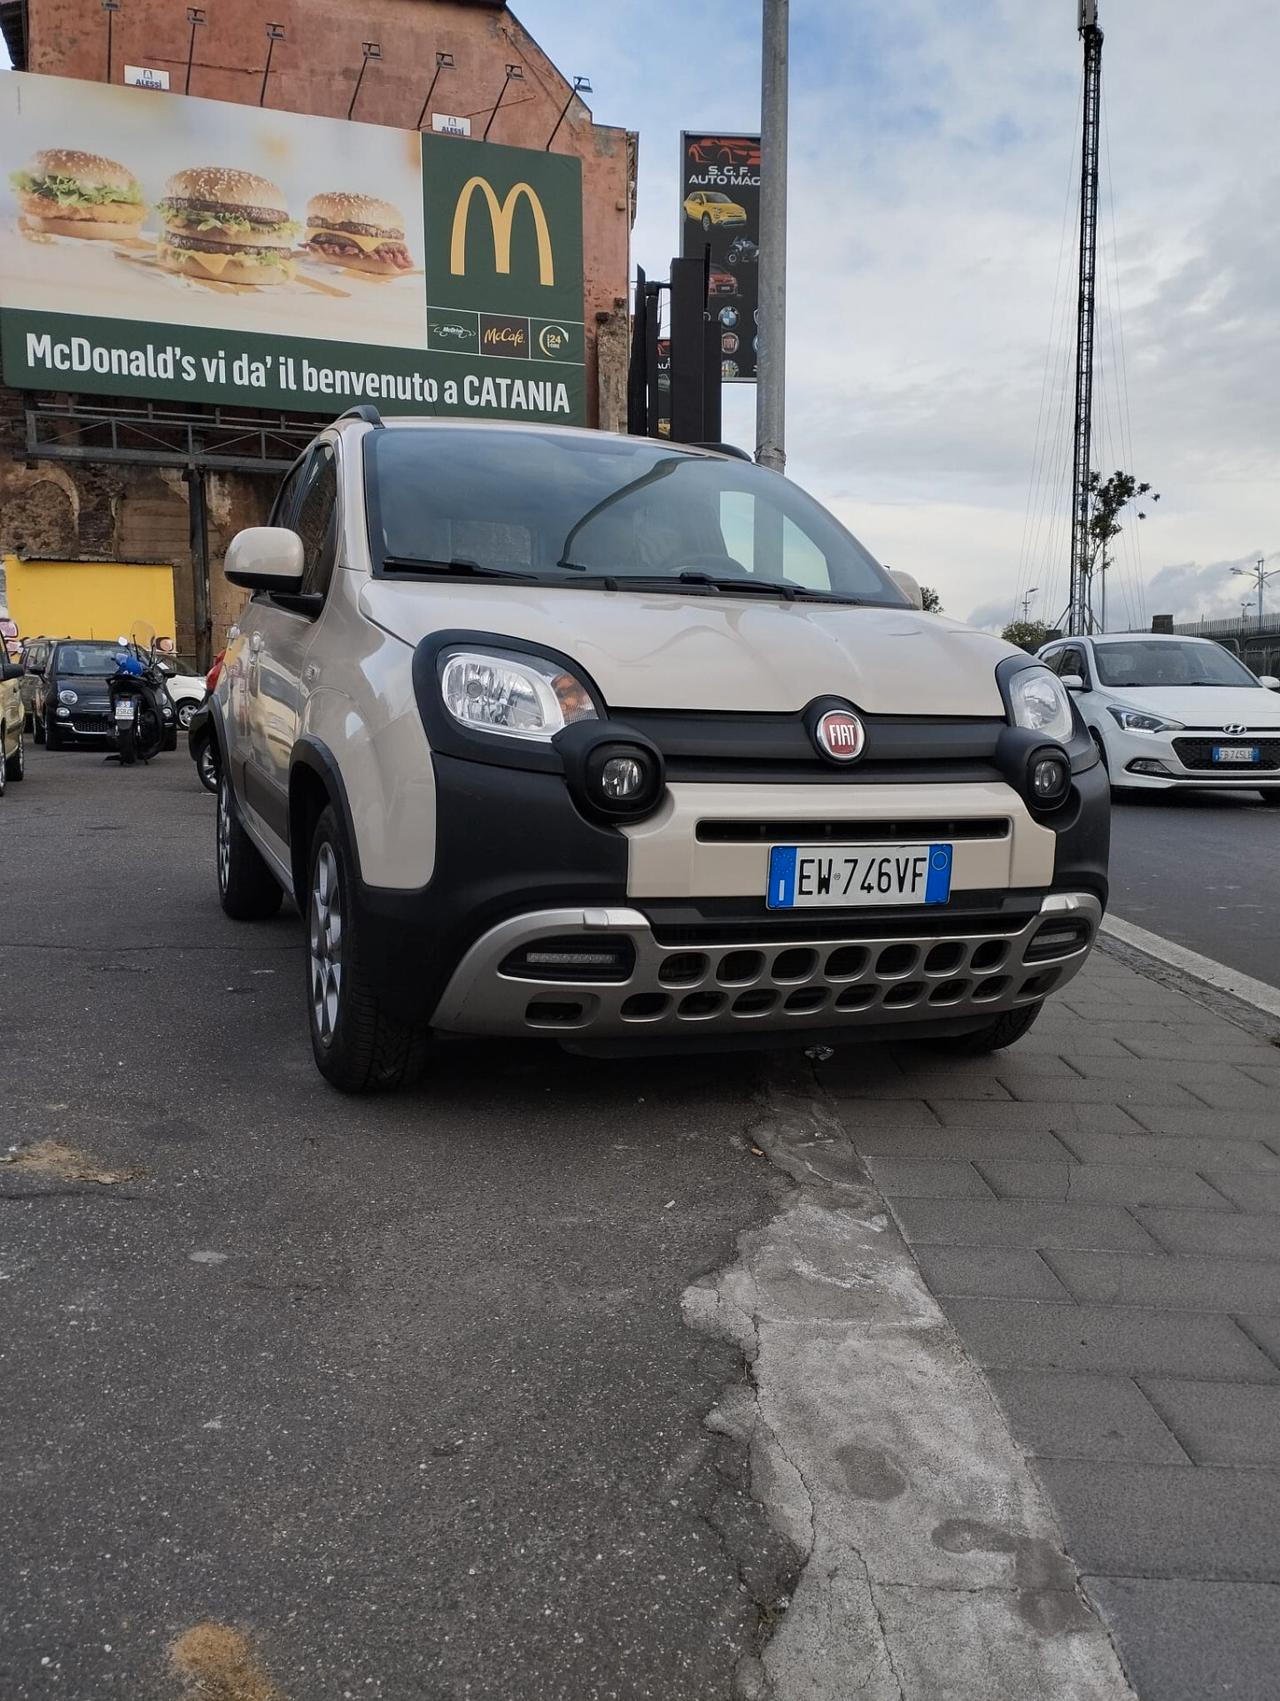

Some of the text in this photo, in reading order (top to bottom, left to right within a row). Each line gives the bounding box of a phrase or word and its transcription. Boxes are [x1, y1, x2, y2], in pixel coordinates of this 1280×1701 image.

[688, 174, 728, 185] AUTO
[26, 332, 571, 414] McDonald's vi da' il benvenuto a CATANIA
[829, 724, 855, 746] FIAT
